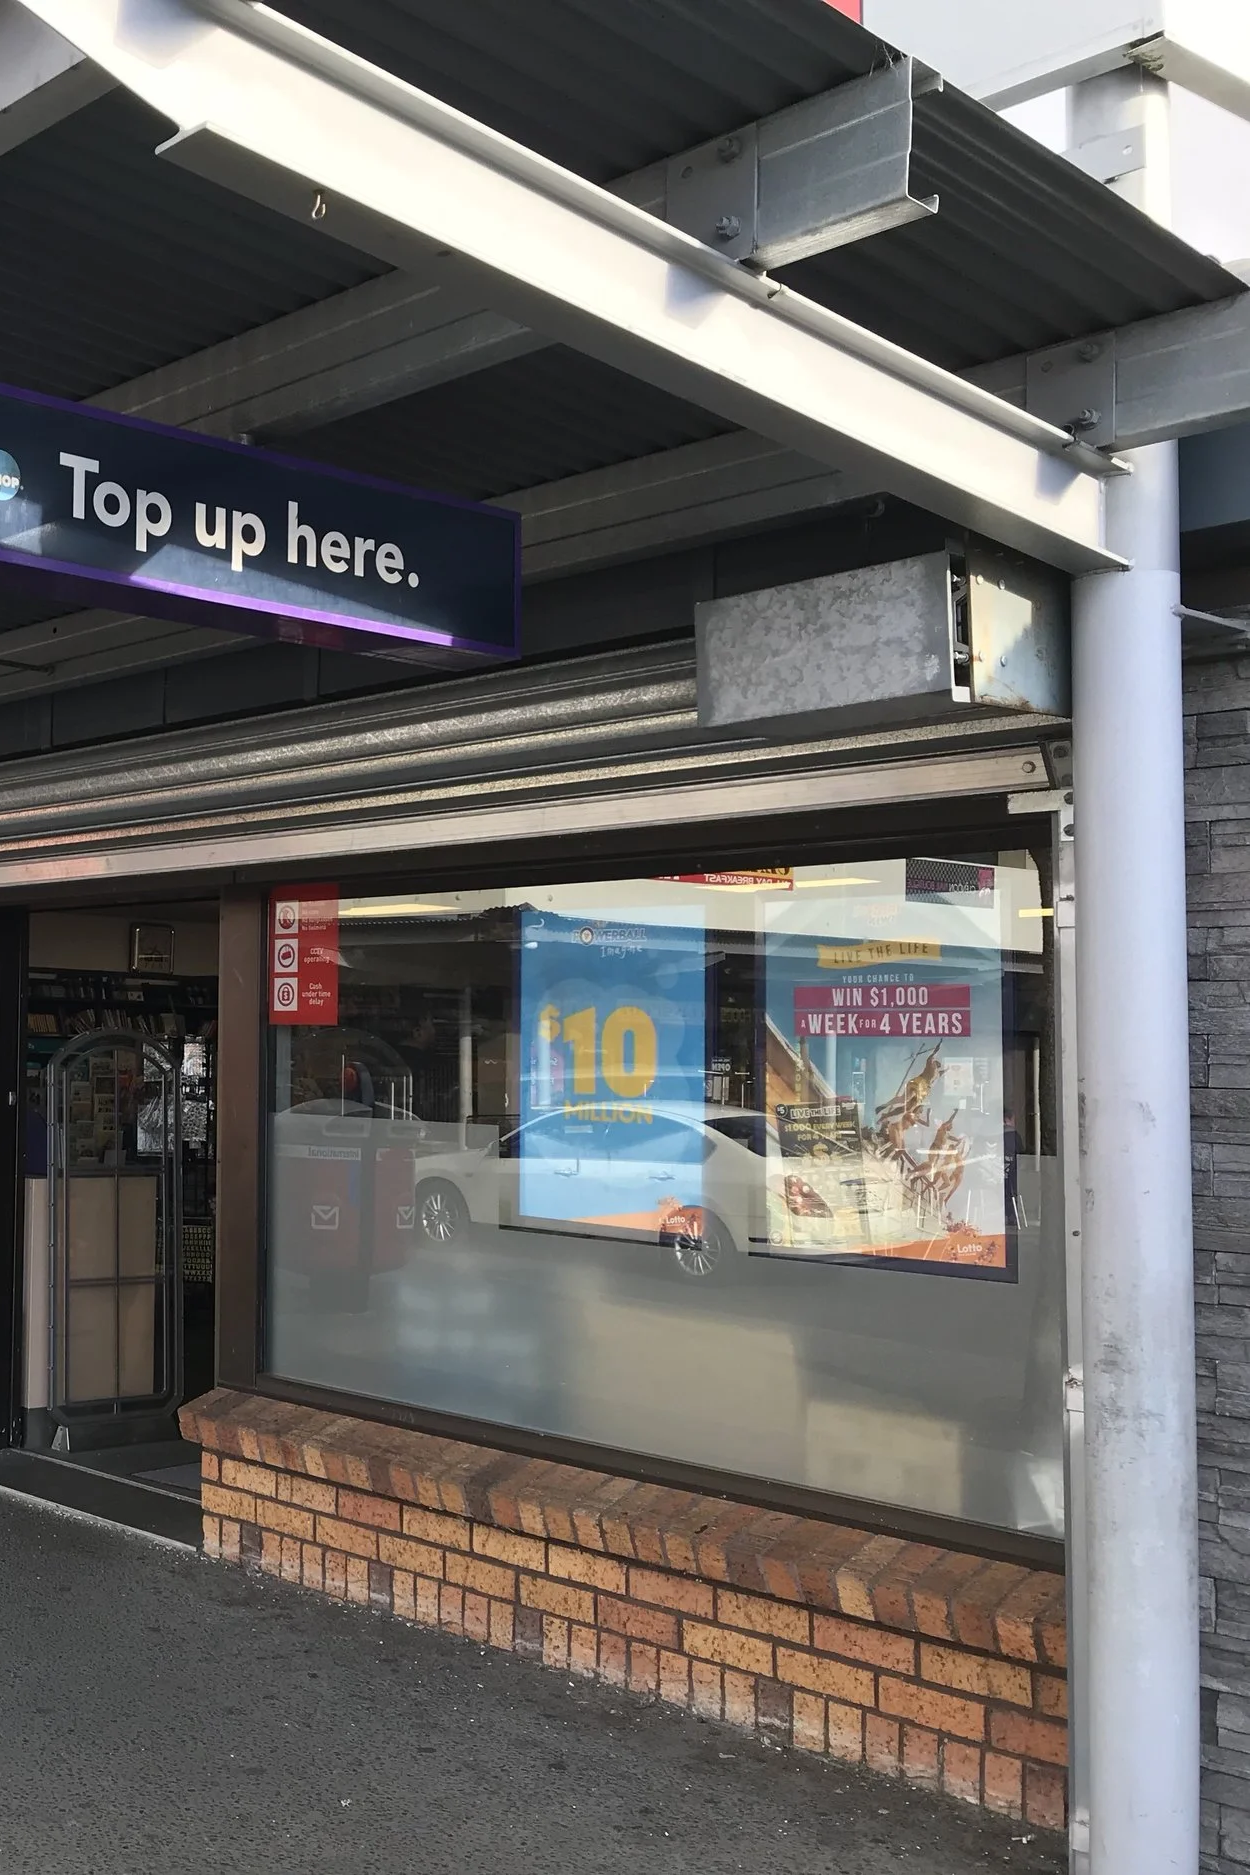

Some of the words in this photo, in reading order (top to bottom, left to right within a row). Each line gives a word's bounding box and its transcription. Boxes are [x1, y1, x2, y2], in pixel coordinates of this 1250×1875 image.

[59, 452, 173, 552] Top
[195, 501, 266, 572] up
[287, 500, 420, 588] here.
[304, 955, 330, 964] operating
[834, 951, 861, 964] LIVE
[868, 944, 892, 960] THE
[900, 942, 929, 955] LIFE
[842, 975, 863, 984] YOUR
[867, 974, 899, 983] CHANCE
[904, 973, 914, 982] TO
[309, 982, 322, 990] Cash
[309, 998, 324, 1006] delay
[832, 988, 863, 1007] WIN
[870, 987, 929, 1007] $1,000
[801, 1020, 806, 1028] A
[808, 1013, 858, 1034] WEEK
[859, 1019, 876, 1028] FOR
[879, 1013, 891, 1034] 4
[899, 1012, 962, 1034] YEARS
[538, 1001, 658, 1098] $10
[563, 1099, 654, 1124] MILLION
[790, 1108, 810, 1119] LIVE
[822, 1105, 841, 1117] LIFE
[666, 1215, 686, 1224] Lotto
[957, 1243, 983, 1253] Lotto
